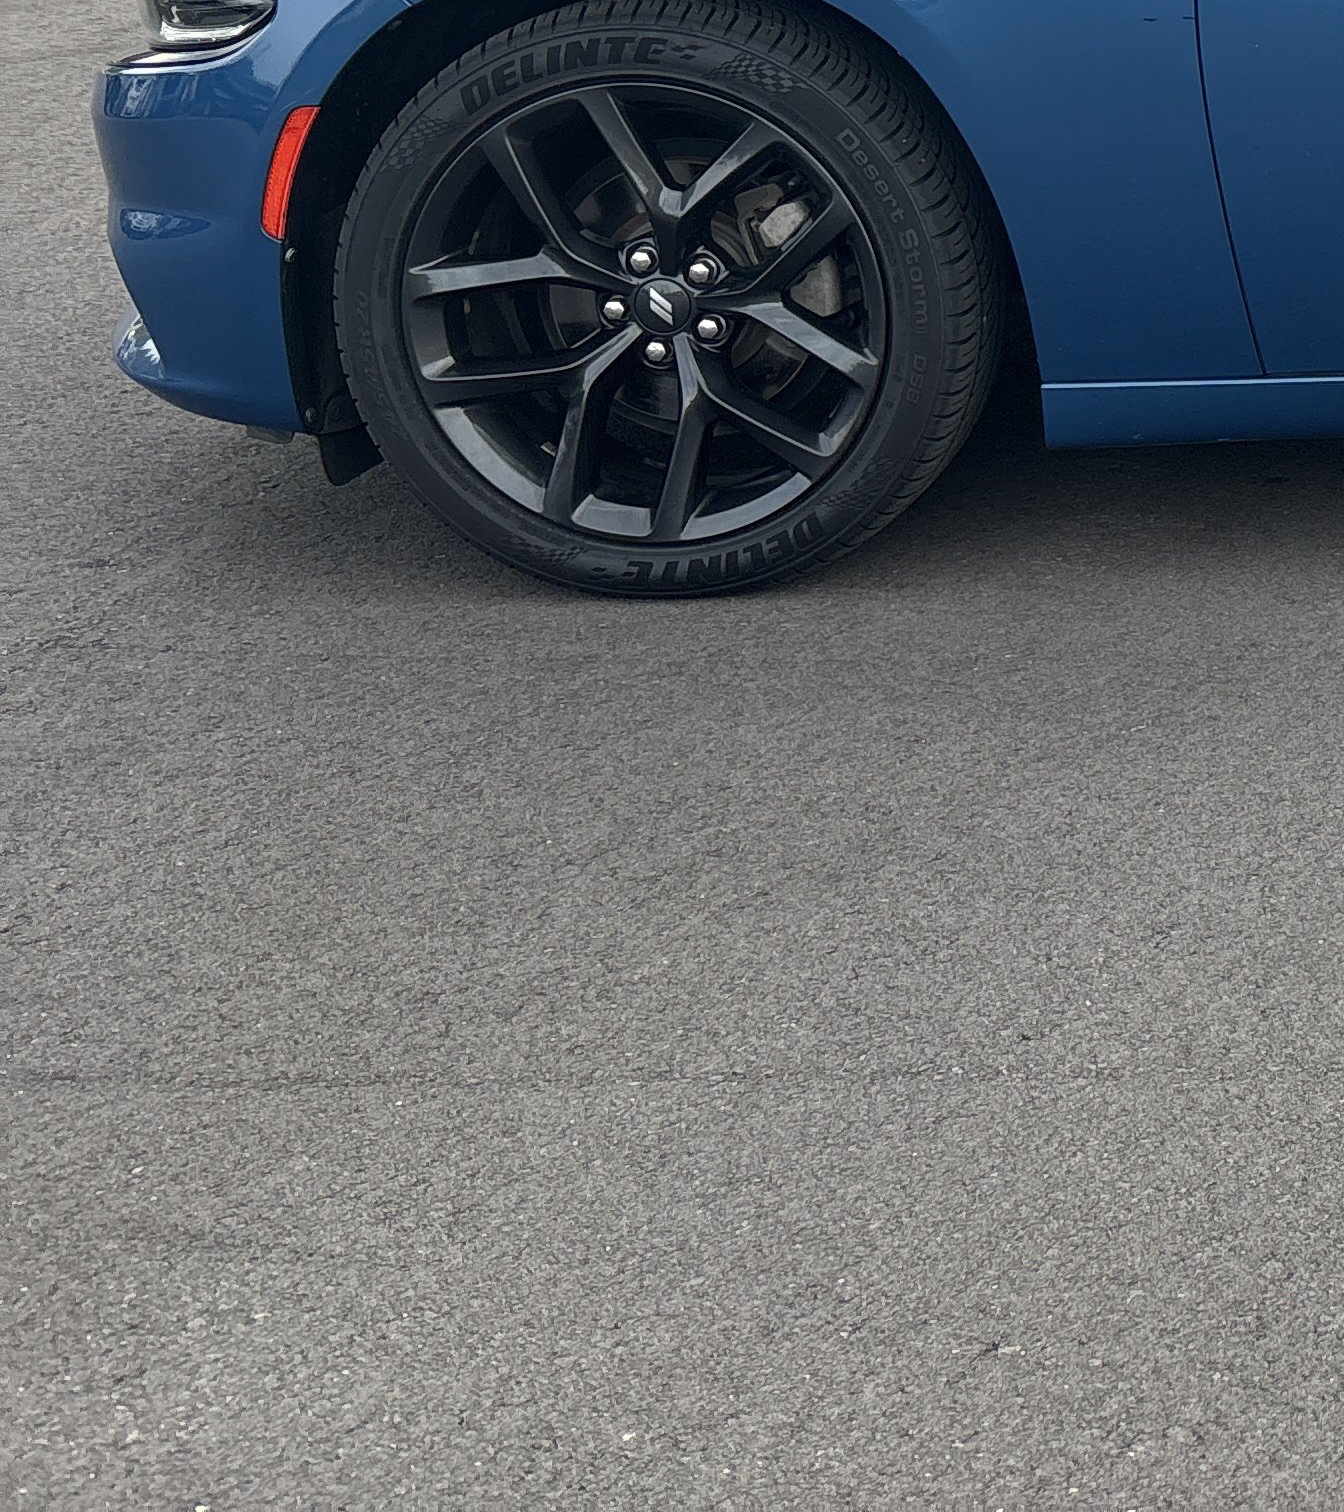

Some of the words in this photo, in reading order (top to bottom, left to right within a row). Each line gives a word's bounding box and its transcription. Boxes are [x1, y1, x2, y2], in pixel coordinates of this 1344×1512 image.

[459, 36, 669, 116] DELINTE
[837, 127, 906, 224] Desert
[620, 510, 826, 585] DELINTE
